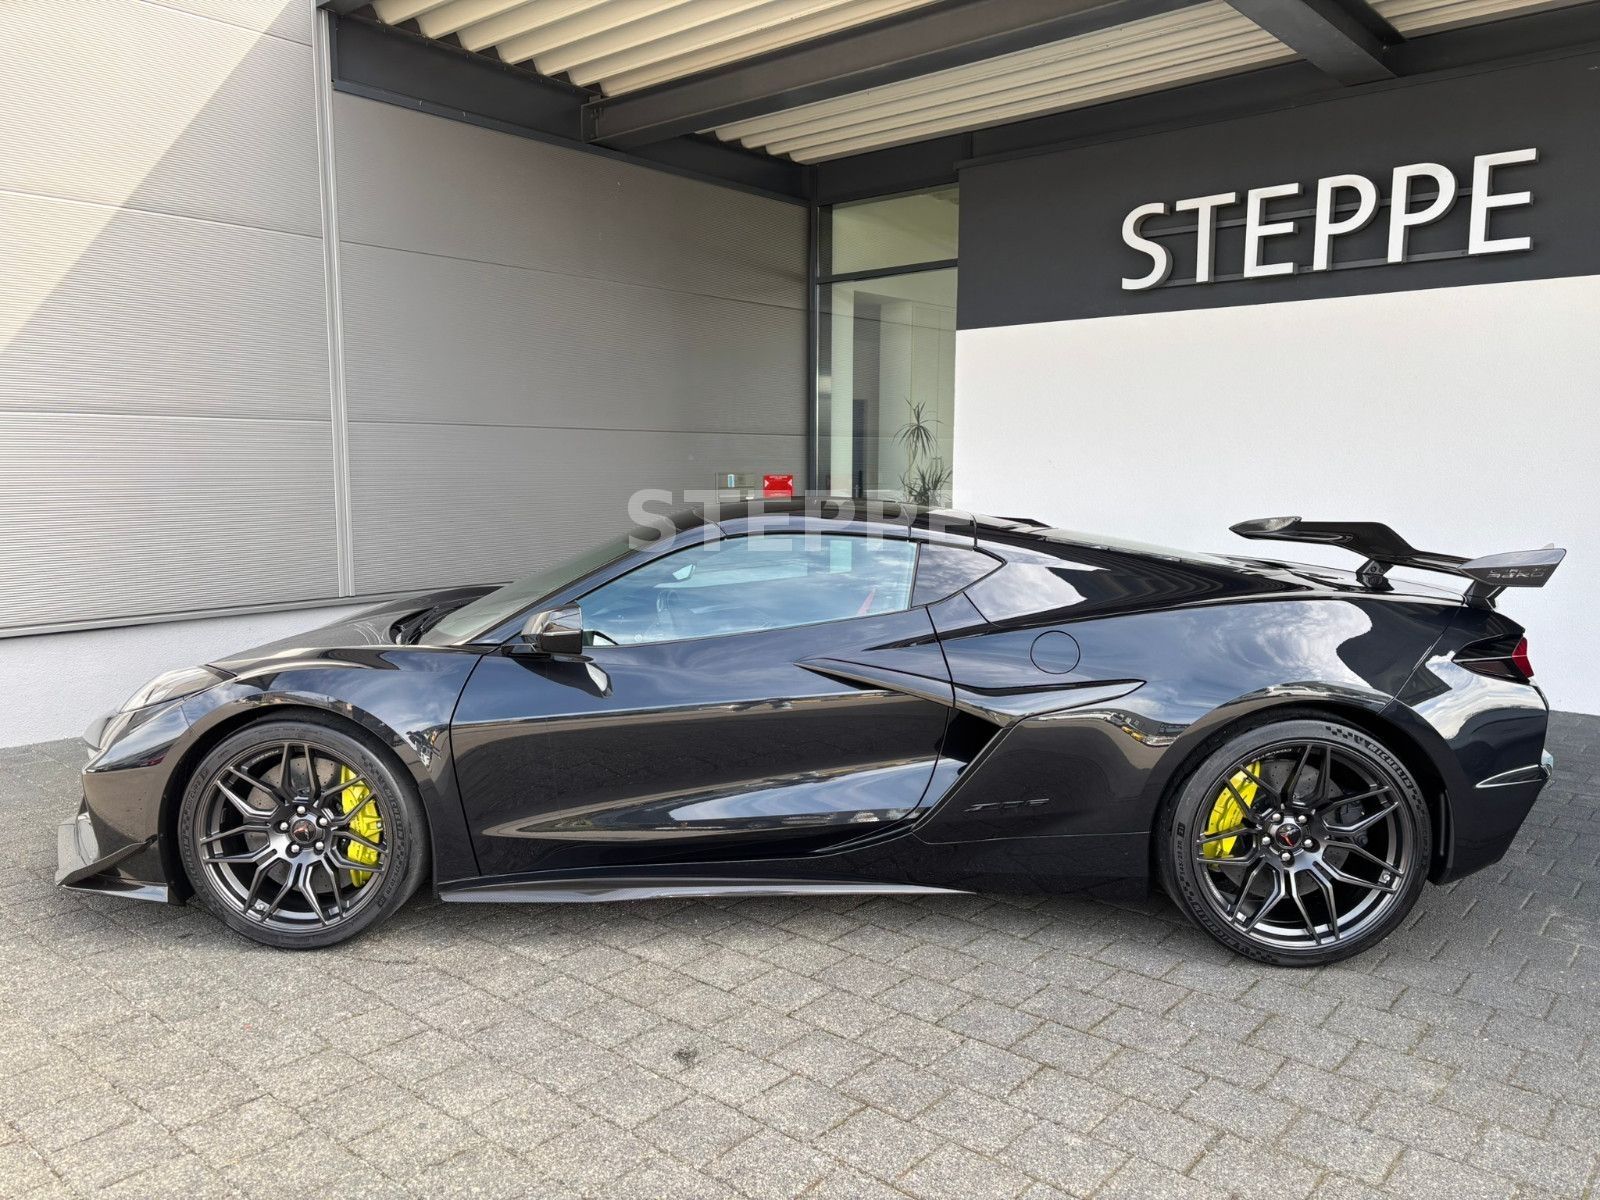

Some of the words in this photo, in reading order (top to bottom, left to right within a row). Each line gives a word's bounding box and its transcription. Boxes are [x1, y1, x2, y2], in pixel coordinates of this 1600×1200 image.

[1121, 147, 1538, 290] STEPPE
[1366, 741, 1414, 788] MICHELIN
[384, 786, 404, 838] MICHELIN
